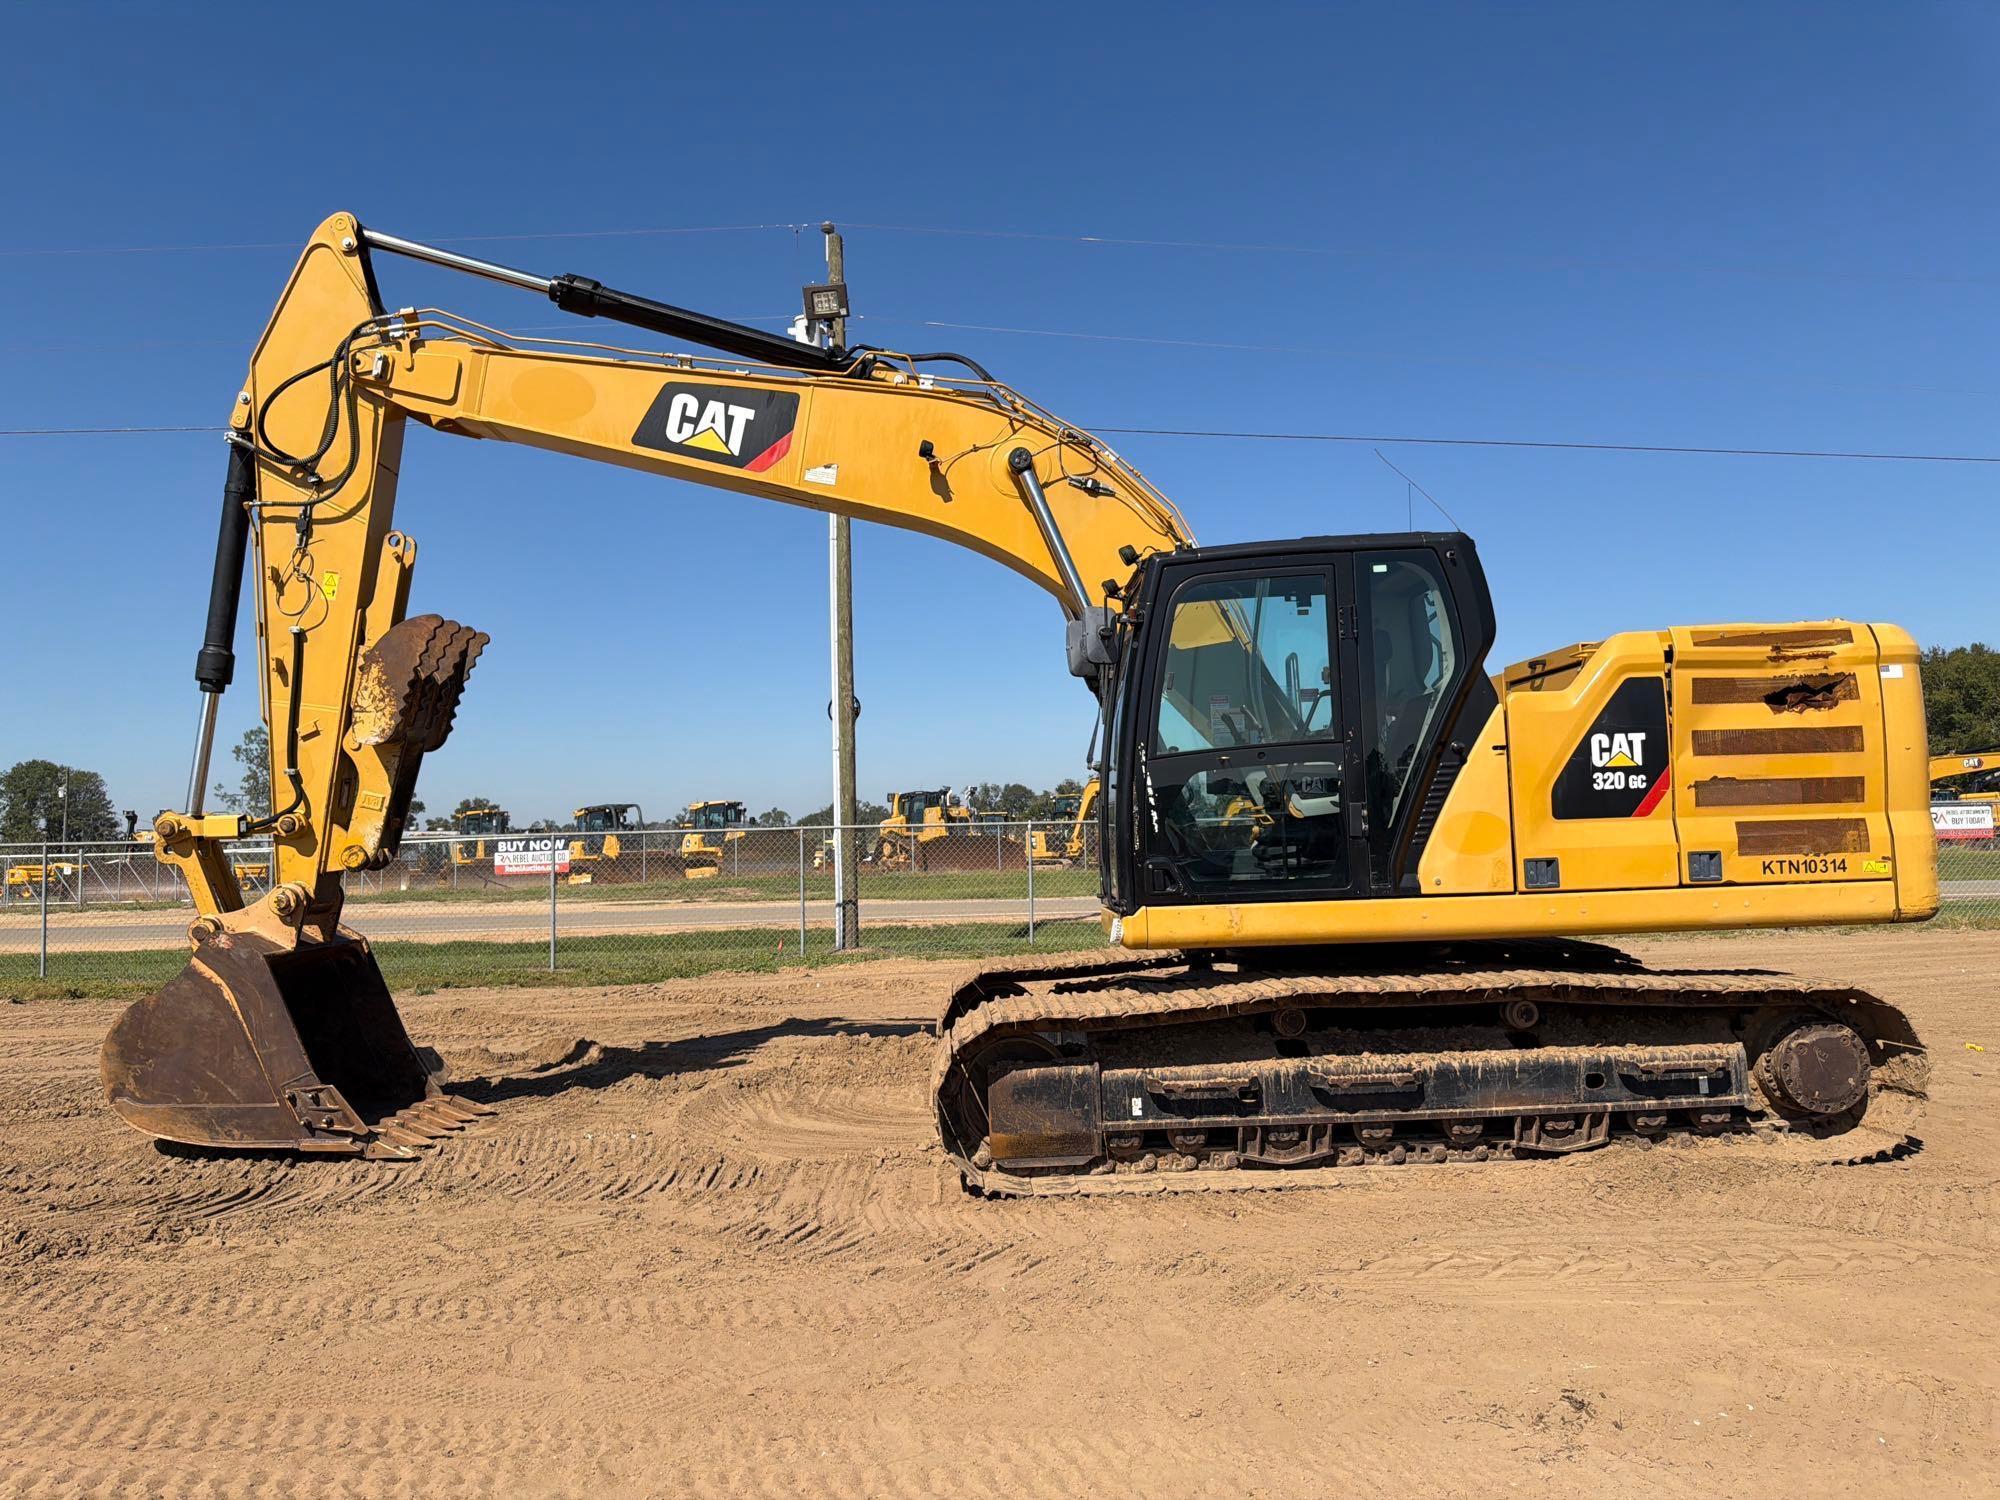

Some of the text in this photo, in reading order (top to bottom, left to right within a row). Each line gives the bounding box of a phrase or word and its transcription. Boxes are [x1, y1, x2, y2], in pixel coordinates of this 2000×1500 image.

[666, 393, 755, 457] CAT
[1590, 732, 1646, 768] CAT
[1963, 758, 1979, 768] CAT
[1592, 771, 1647, 790] 320 GC
[1951, 817, 1964, 825] BUY
[498, 839, 565, 852] BUY NOW
[513, 854, 529, 863] REBEL
[531, 853, 555, 863] AUCTIO
[1762, 858, 1848, 875] KTN10314
